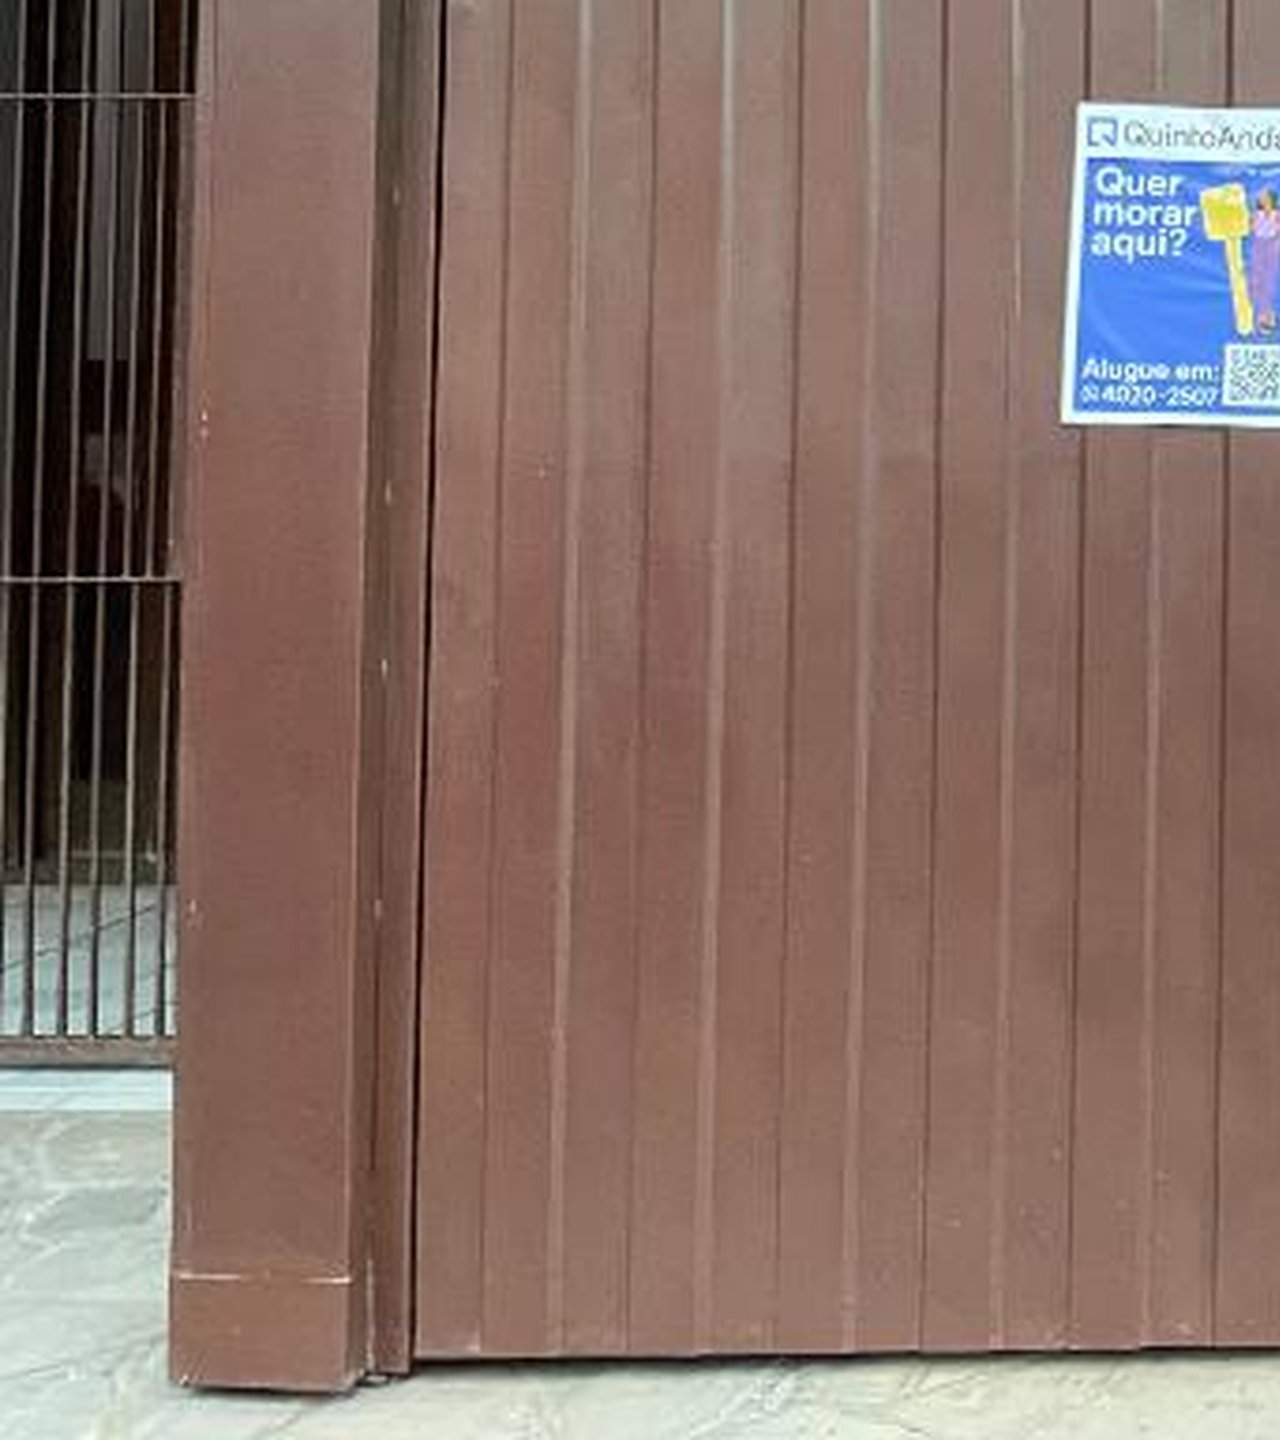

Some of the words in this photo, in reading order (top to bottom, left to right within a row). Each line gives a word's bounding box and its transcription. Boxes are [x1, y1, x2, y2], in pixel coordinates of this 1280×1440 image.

[1094, 167, 1183, 199] Quer
[1092, 201, 1198, 227] morar
[1090, 228, 1187, 262] aqui?
[1081, 358, 1170, 382] Alugue
[1174, 364, 1222, 382] em:
